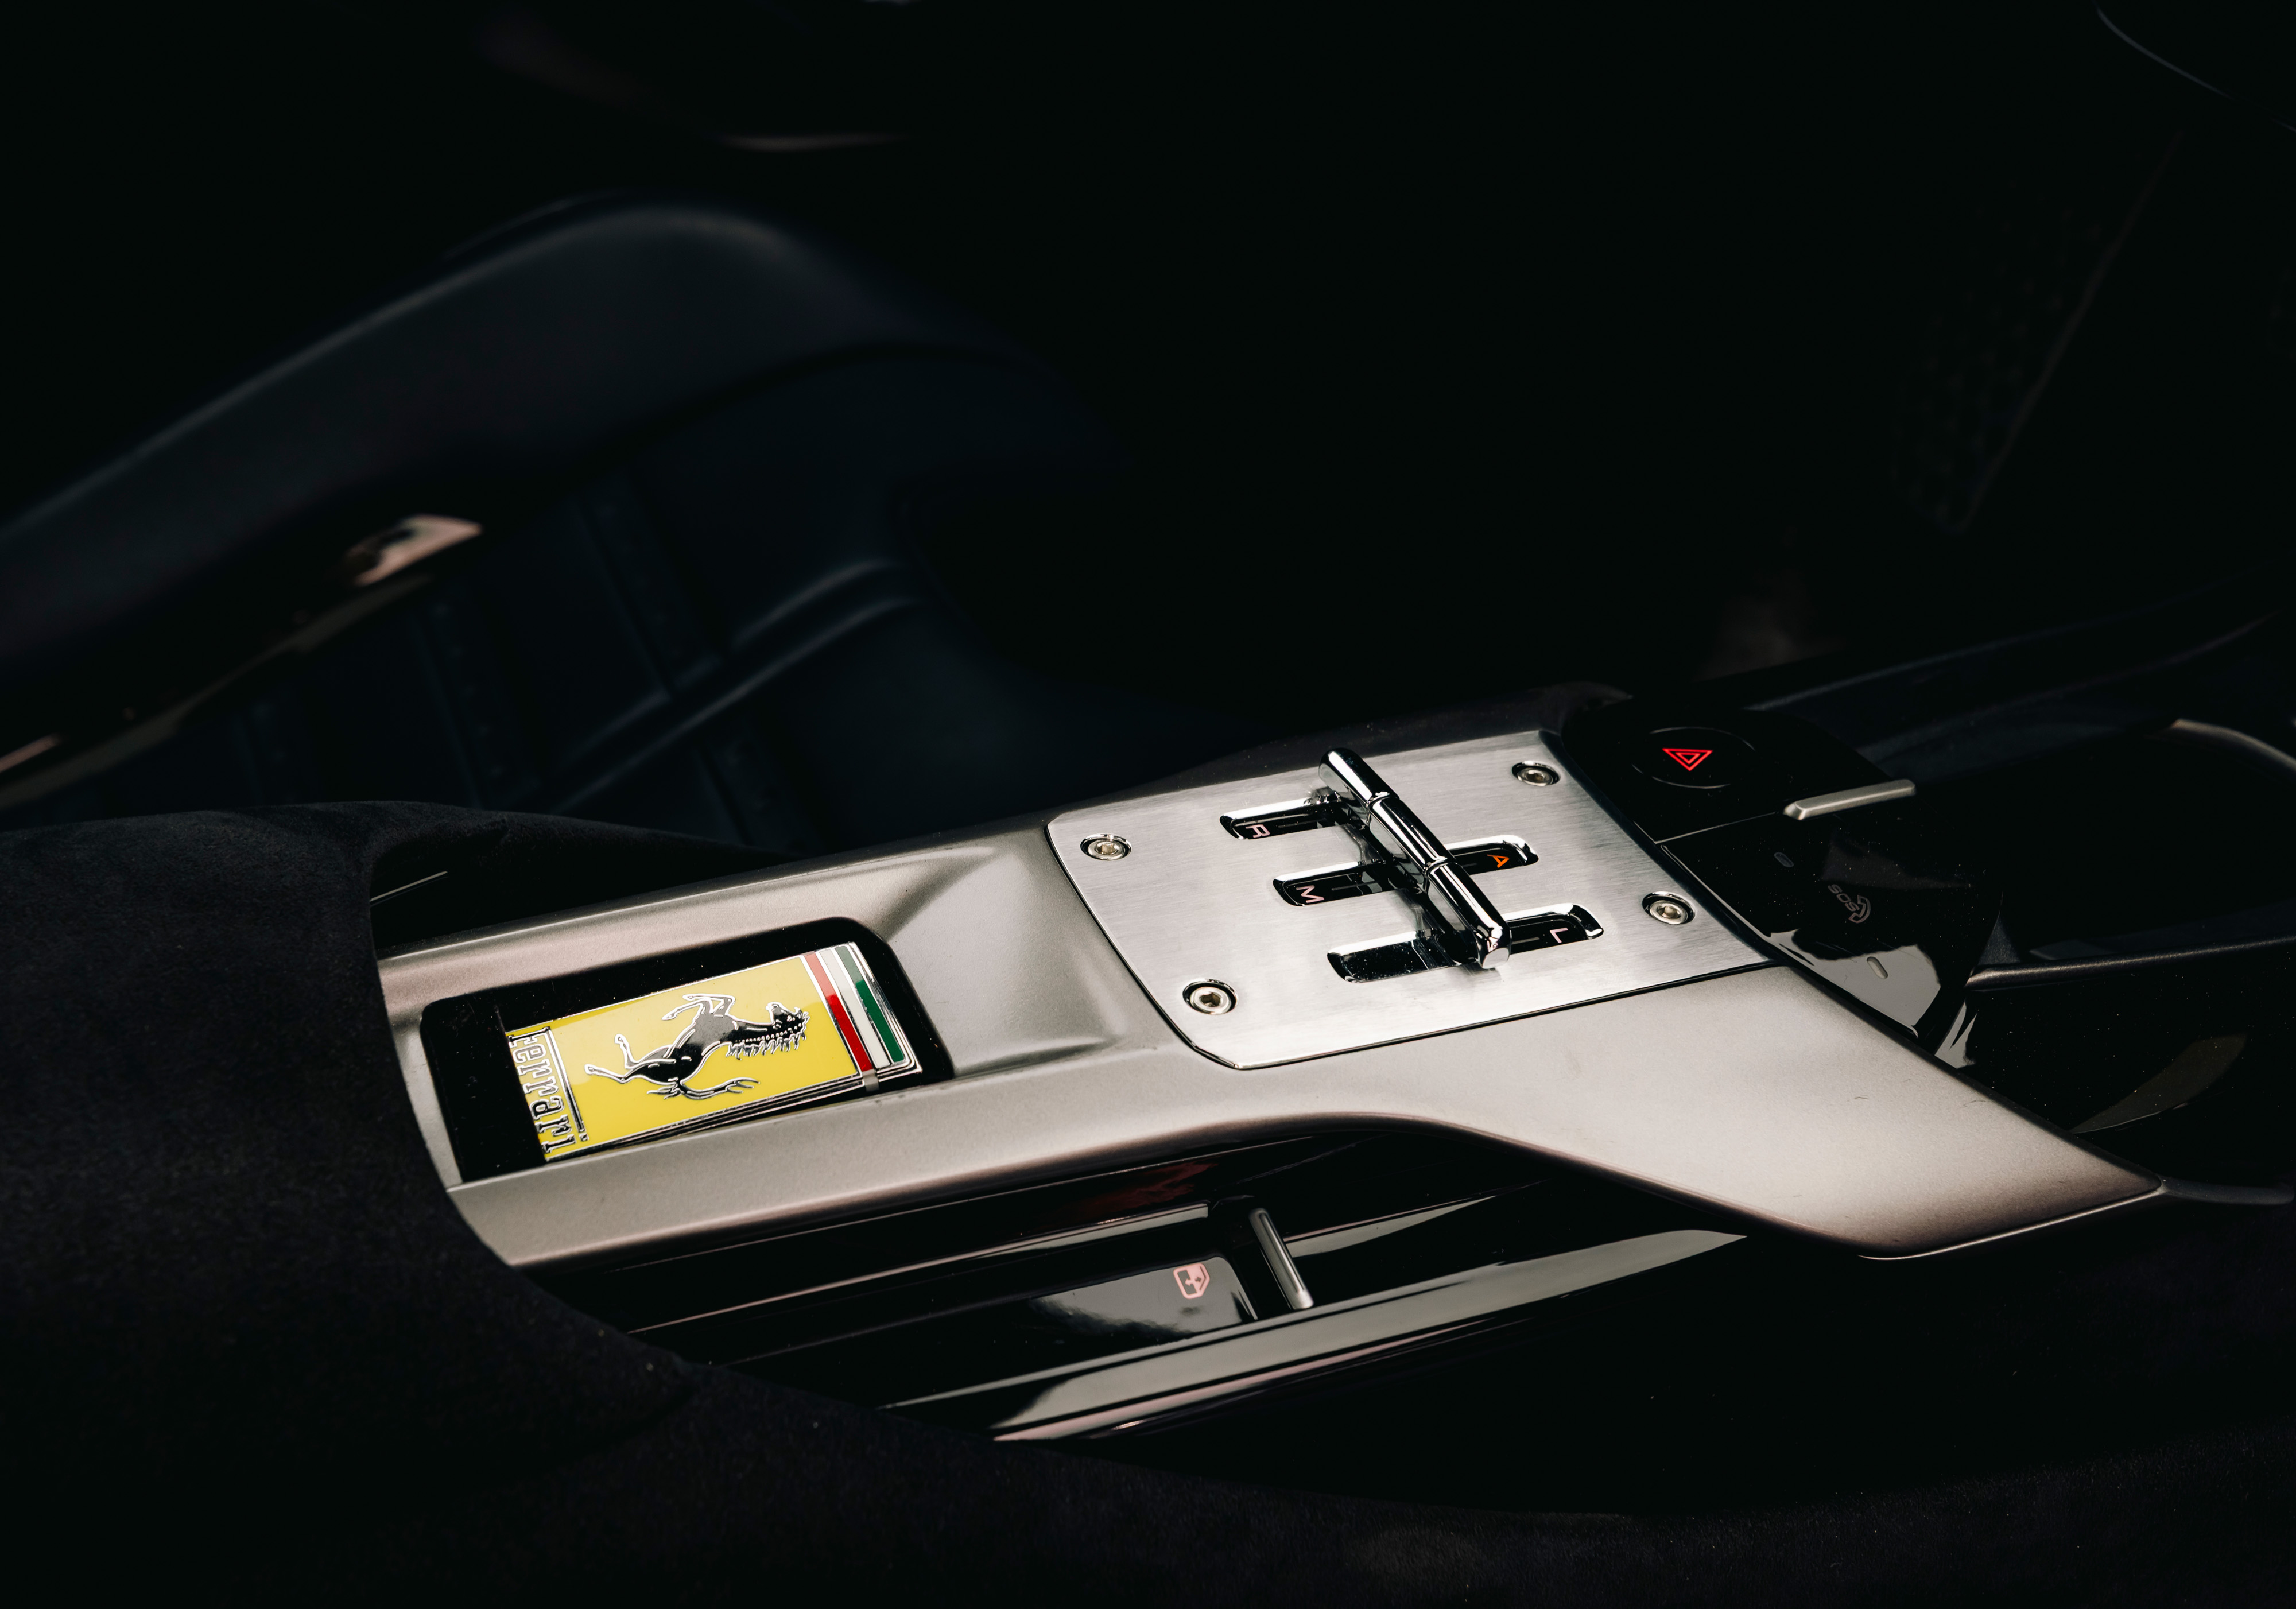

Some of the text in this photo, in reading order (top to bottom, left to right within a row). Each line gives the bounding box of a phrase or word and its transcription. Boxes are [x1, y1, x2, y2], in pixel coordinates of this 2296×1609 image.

[1245, 824, 1270, 838] R
[1487, 854, 1510, 869] A
[1296, 884, 1325, 904] M
[1827, 883, 1860, 912] SOS
[1549, 927, 1569, 944] L
[507, 1026, 589, 1153] Ferrari
